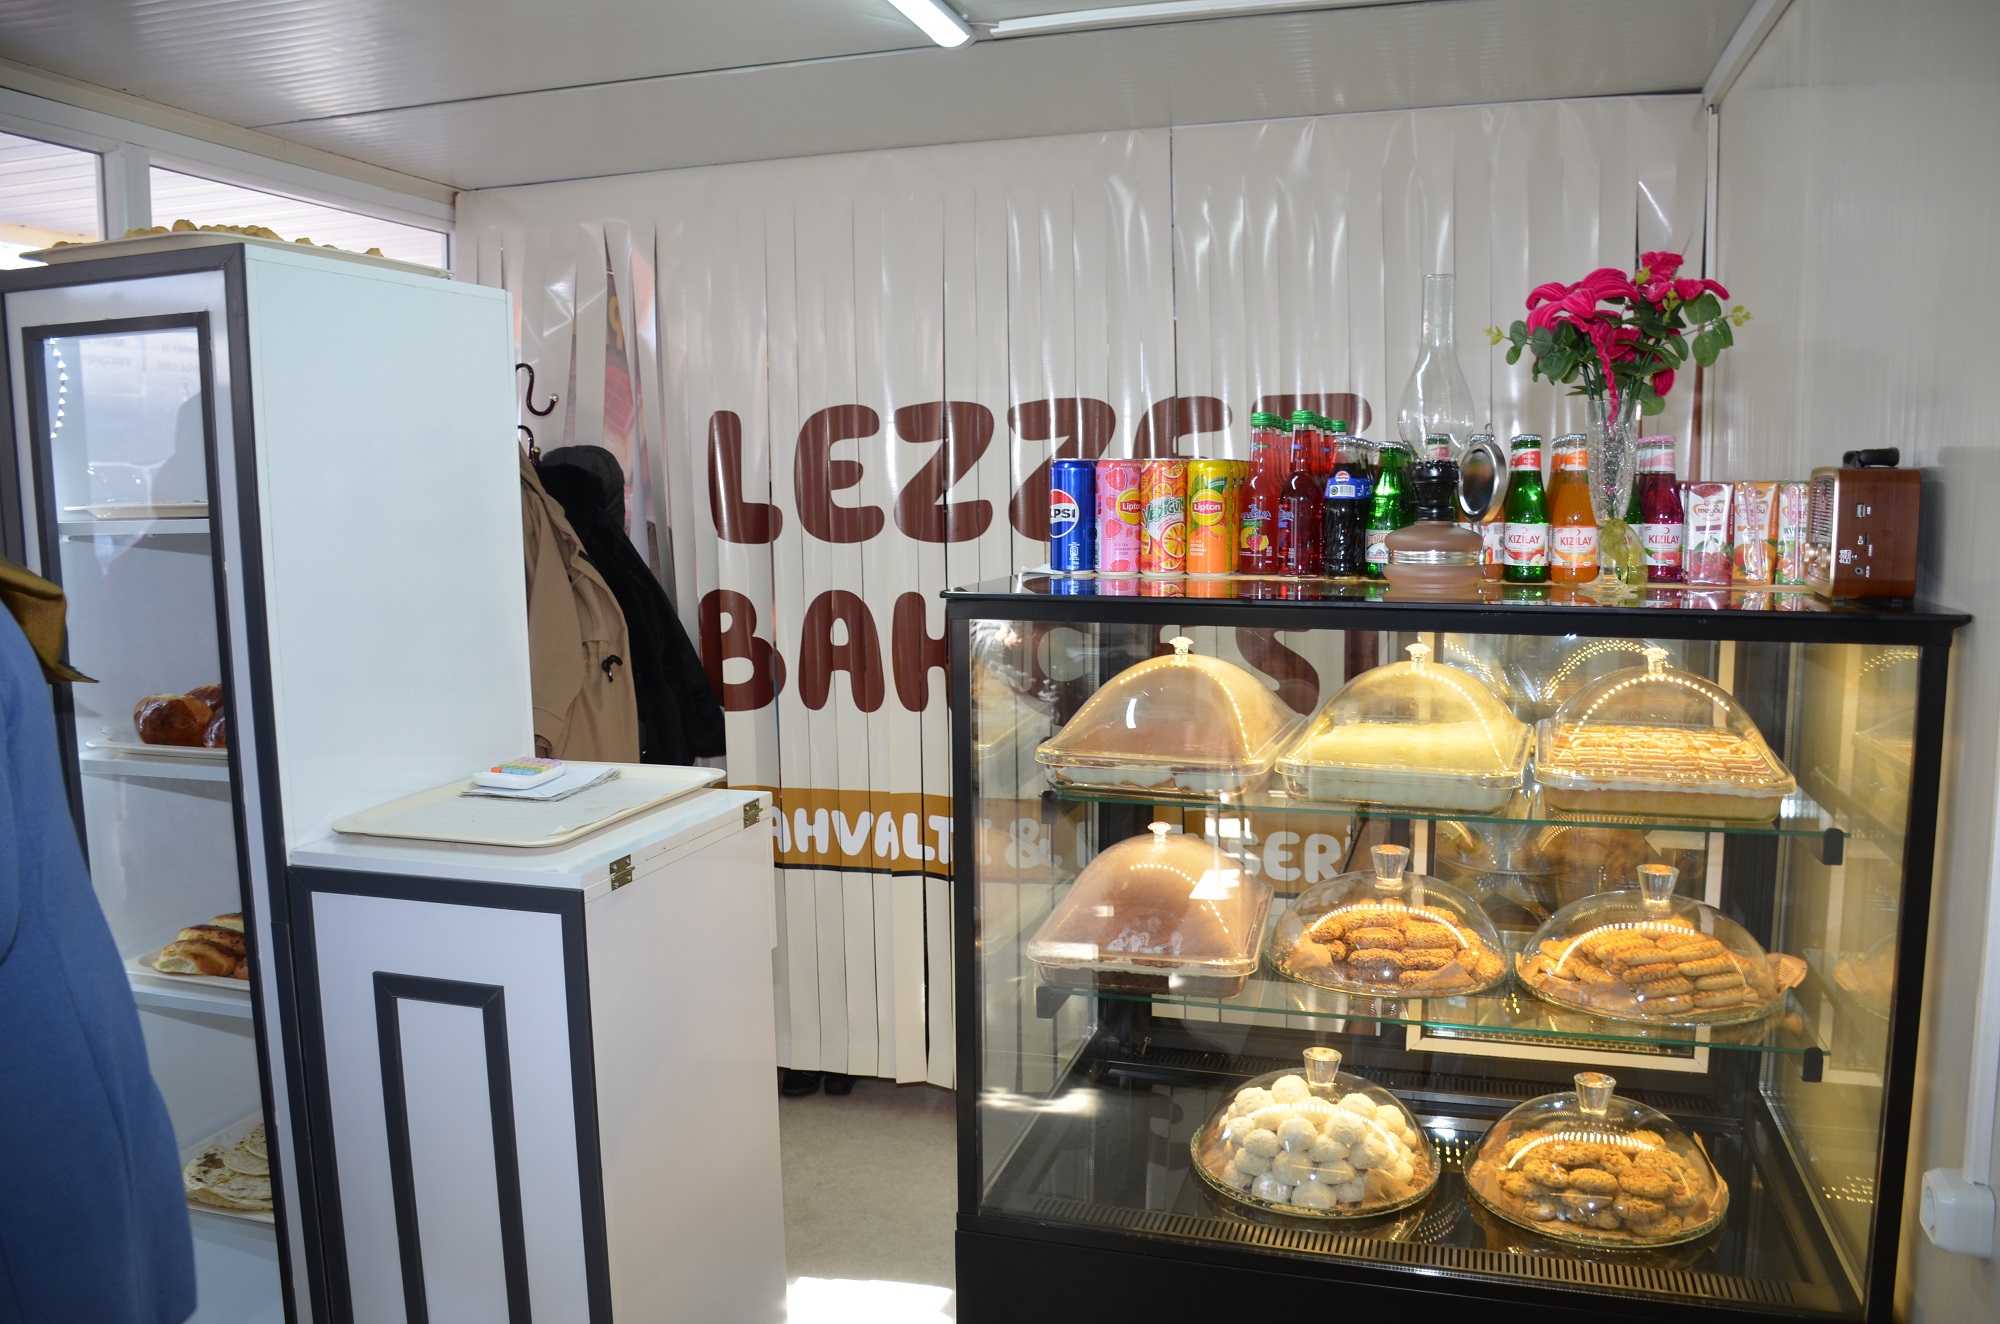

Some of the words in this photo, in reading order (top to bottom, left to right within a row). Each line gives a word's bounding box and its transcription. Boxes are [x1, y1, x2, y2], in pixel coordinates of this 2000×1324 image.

[1193, 503, 1221, 513] Lipton
[1050, 508, 1076, 519] PSI
[1508, 534, 1541, 544] KIZILAY
[1560, 535, 1593, 546] KIZILAY
[1648, 534, 1680, 544] KIZILAY
